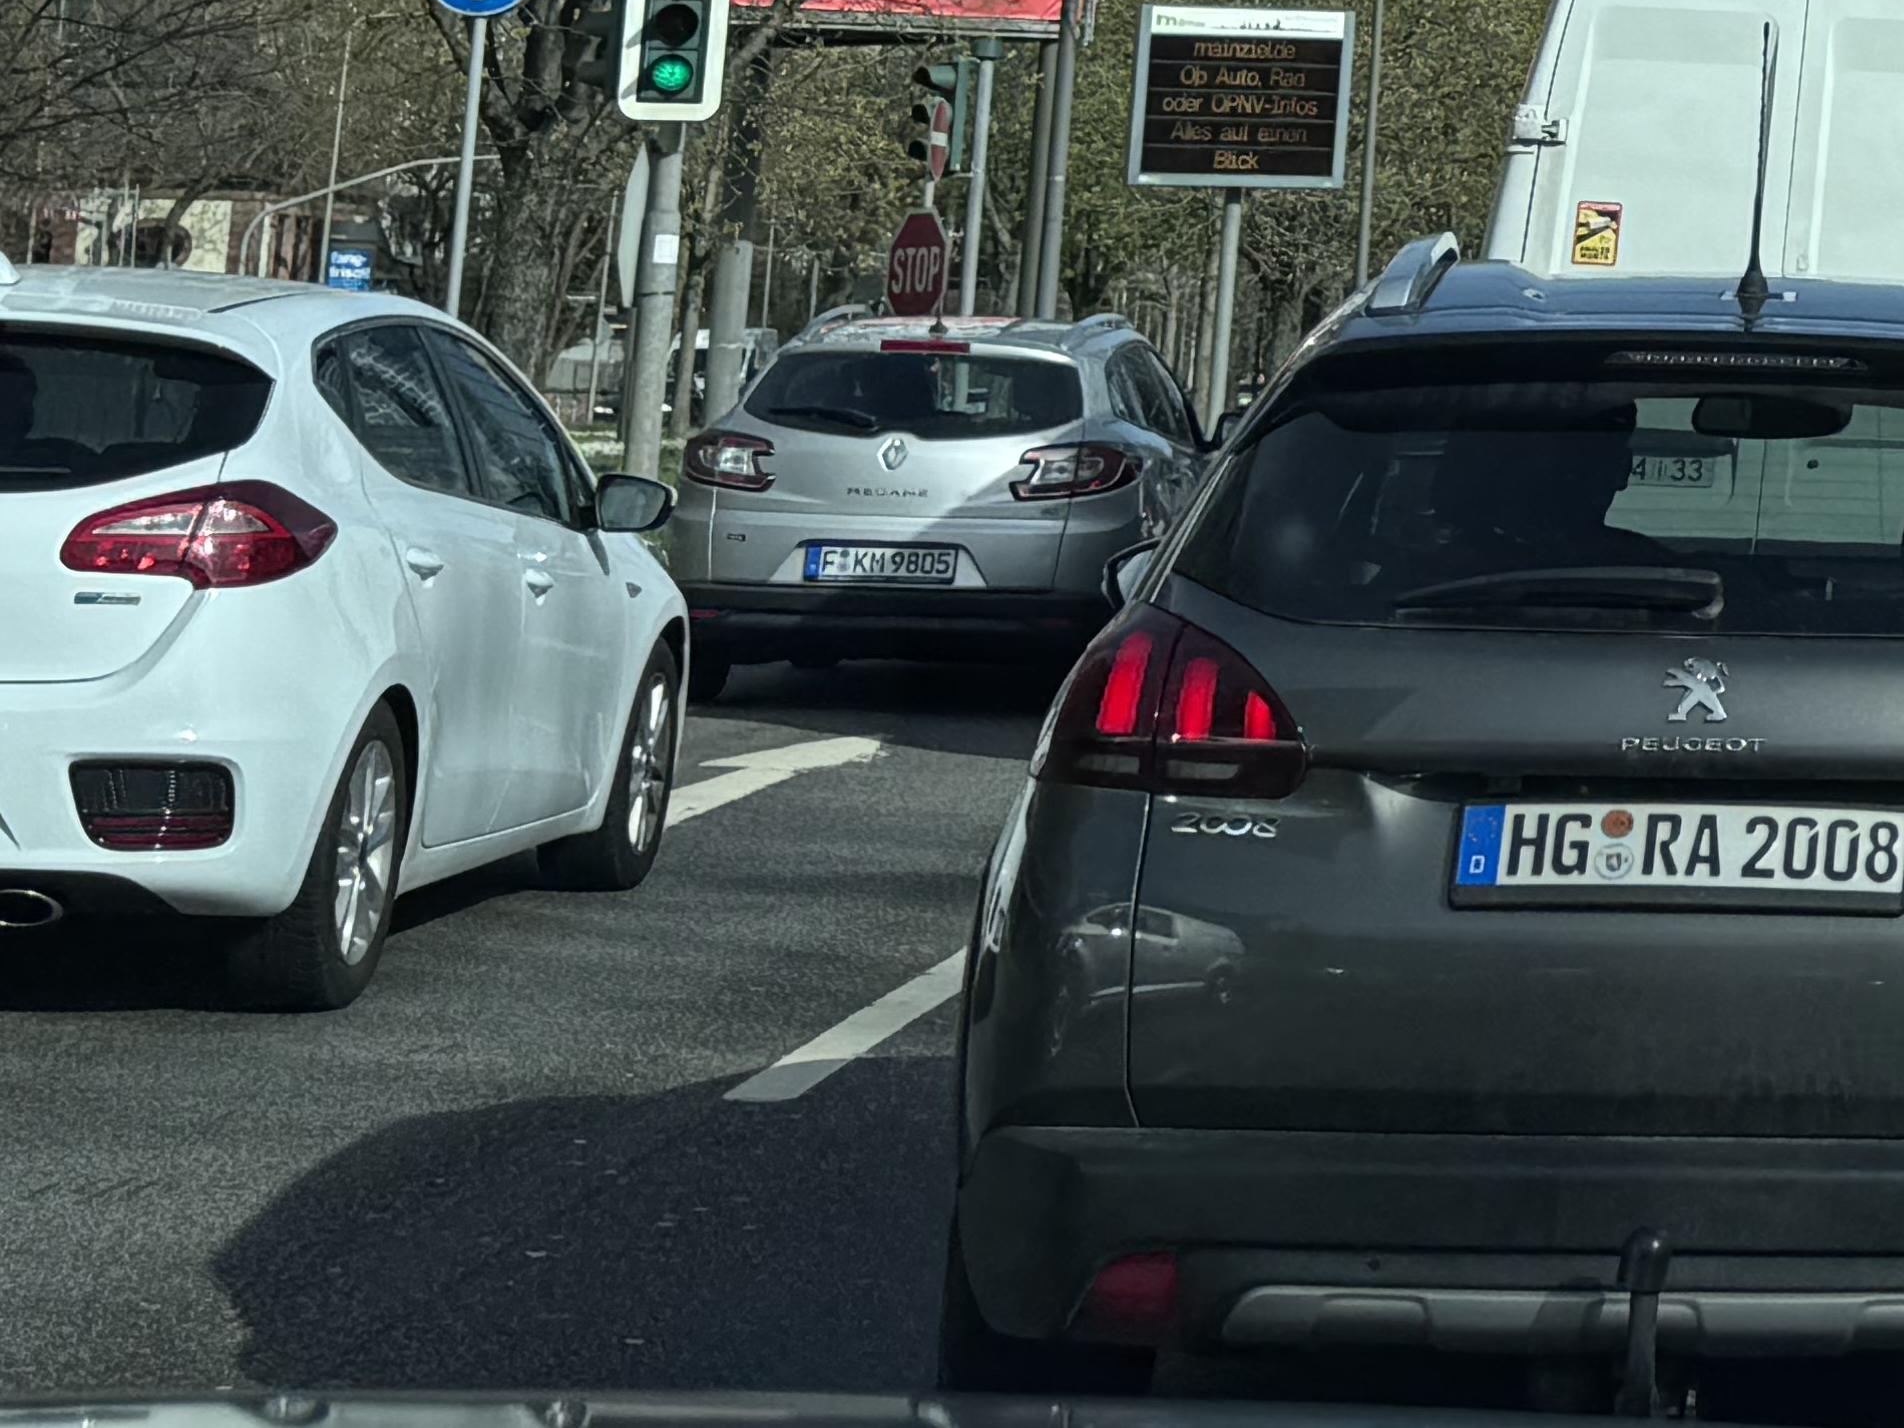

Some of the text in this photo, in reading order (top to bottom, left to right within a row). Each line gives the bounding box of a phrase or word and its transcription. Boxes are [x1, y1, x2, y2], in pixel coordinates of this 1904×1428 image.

[1162, 92, 1204, 112] oder
[1170, 121, 1213, 141] Alles
[1219, 124, 1249, 142] auf
[1213, 150, 1260, 170] Blick
[890, 246, 942, 294] STOP
[822, 550, 952, 575] F KM 9805
[1620, 736, 1767, 753] PEUGEOT
[1170, 811, 1281, 838] 2008
[1505, 812, 1900, 883] HG RA 2008
